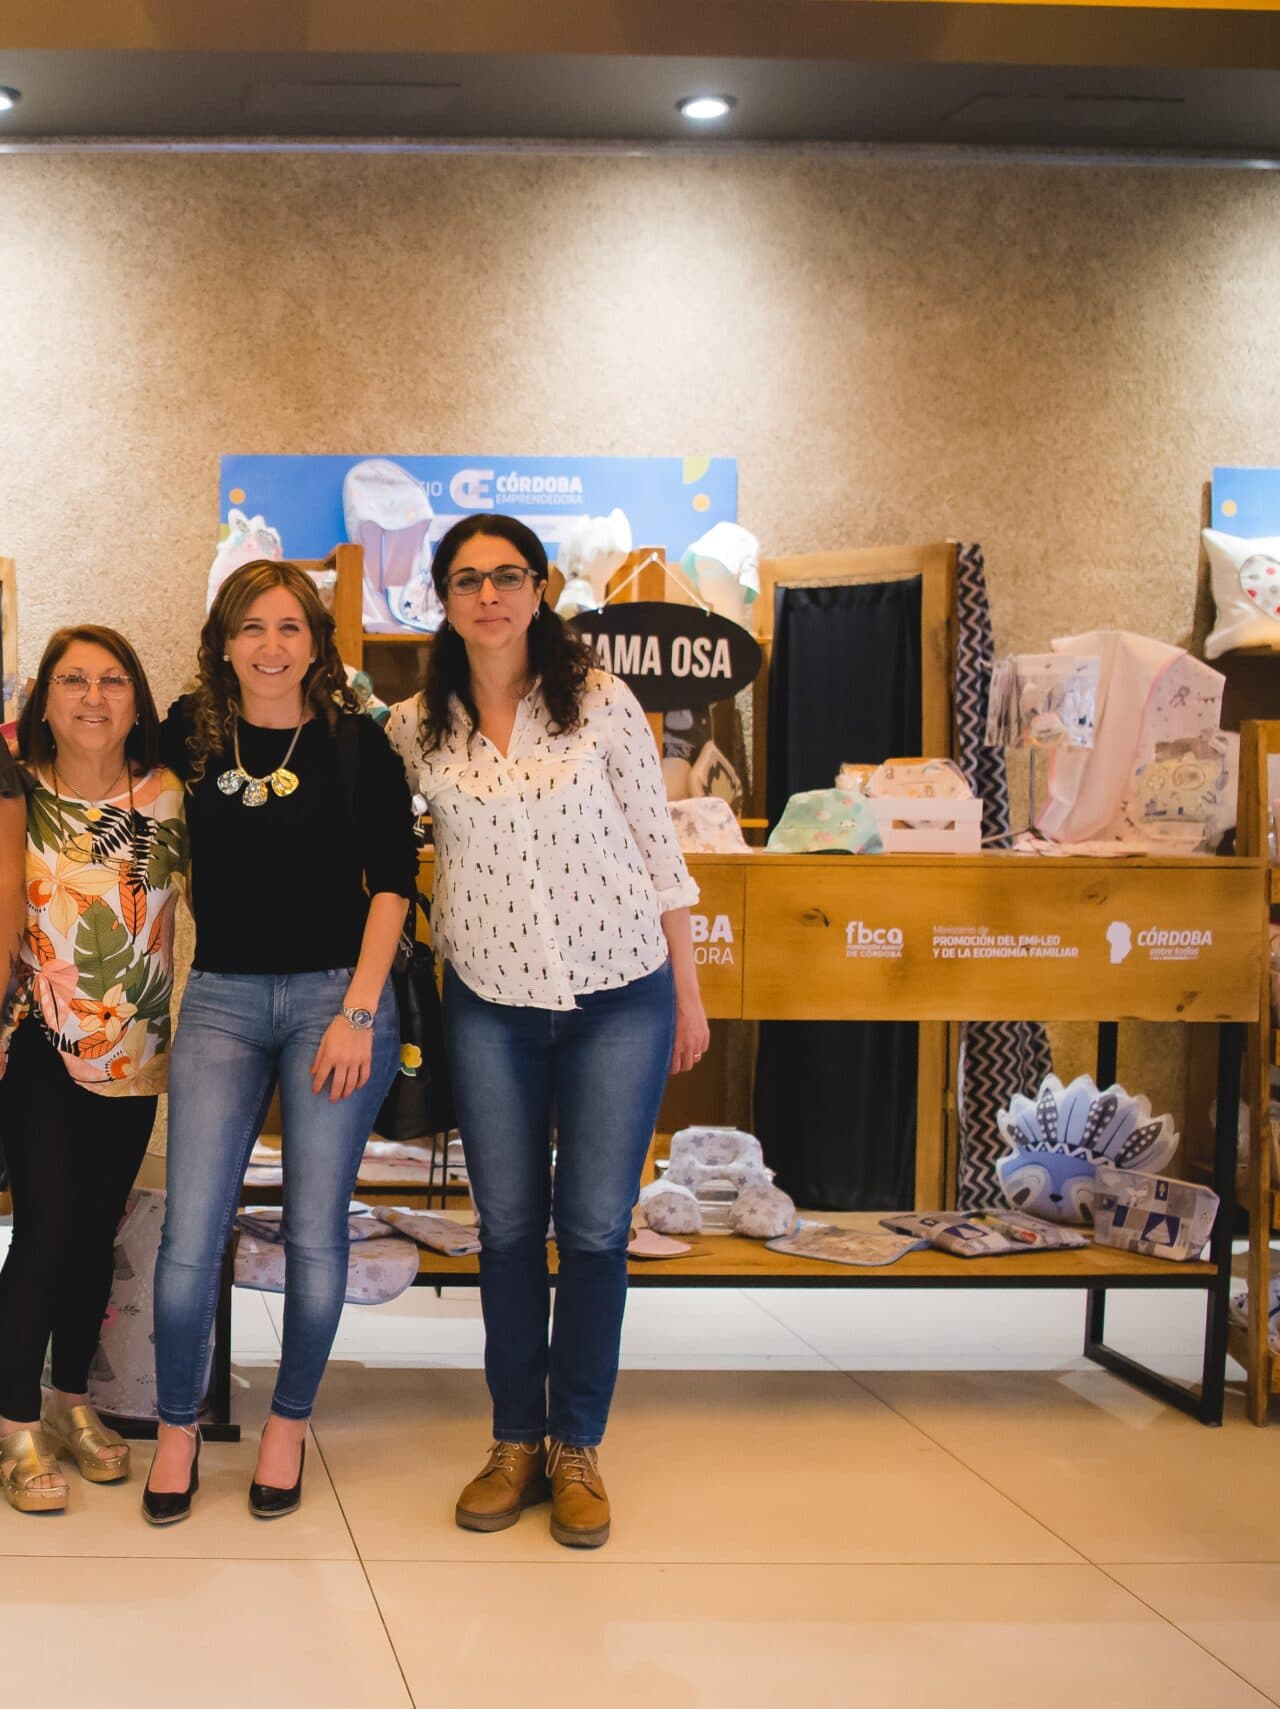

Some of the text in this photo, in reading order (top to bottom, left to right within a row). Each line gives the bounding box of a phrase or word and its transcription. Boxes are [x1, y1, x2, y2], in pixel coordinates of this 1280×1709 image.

[496, 471, 583, 493] CÓRDOBA
[671, 636, 732, 679] OSA
[933, 934, 995, 946] PROMOCIÓN
[997, 935, 1016, 946] DEL
[1137, 926, 1213, 946] CÓRDOBA
[933, 947, 941, 958] Y
[942, 947, 955, 958] DE
[957, 947, 971, 958] LA
[1029, 947, 1079, 958] FAMILIAR
